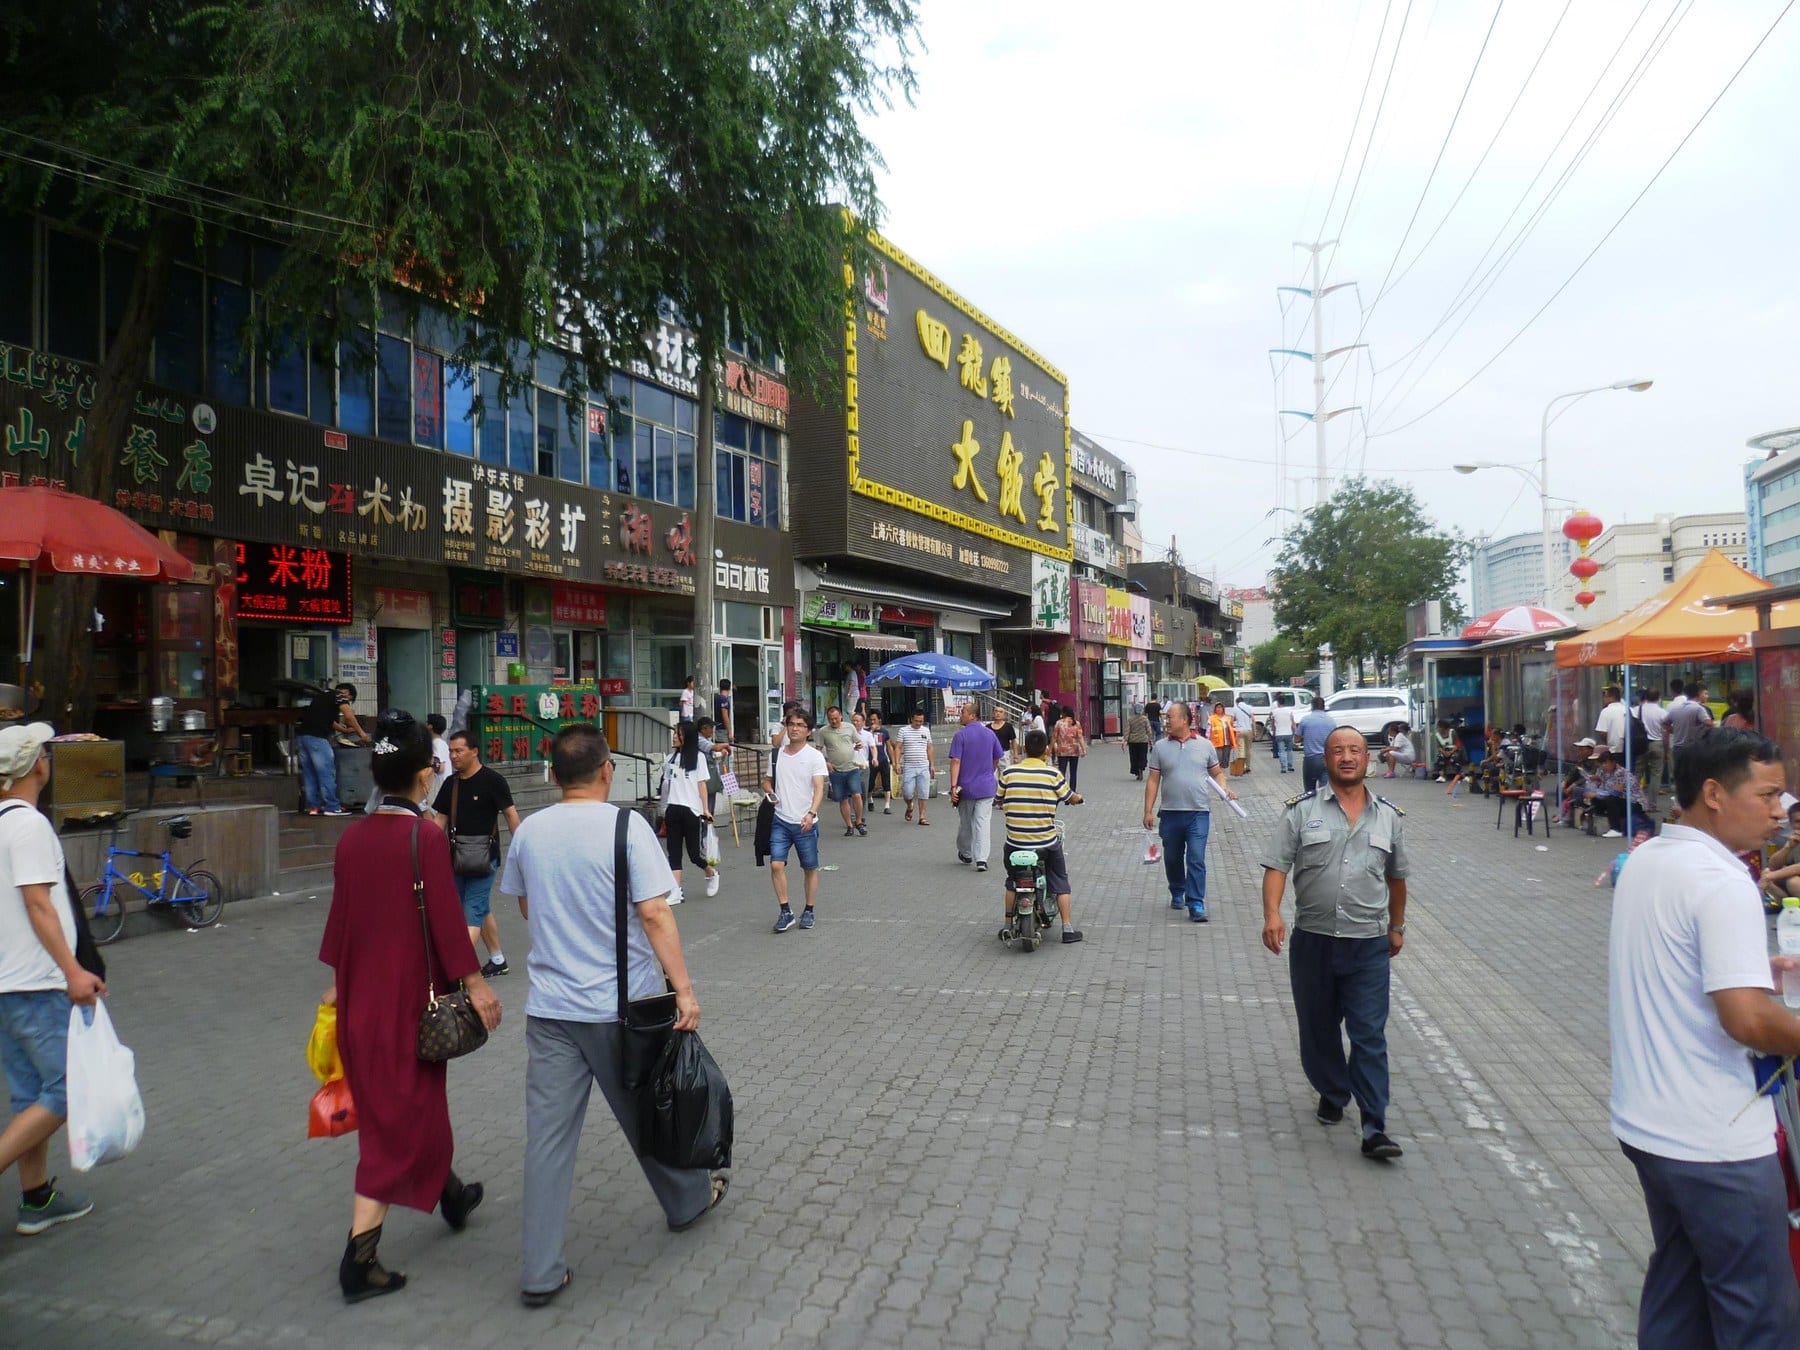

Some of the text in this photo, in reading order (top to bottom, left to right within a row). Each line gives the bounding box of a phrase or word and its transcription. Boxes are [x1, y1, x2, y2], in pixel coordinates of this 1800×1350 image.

[239, 453, 327, 513] 卓记
[472, 464, 525, 494] 快乐天使
[442, 477, 586, 553] 摄影彩扩
[267, 544, 333, 592] 米粉
[560, 693, 600, 719] 米粉
